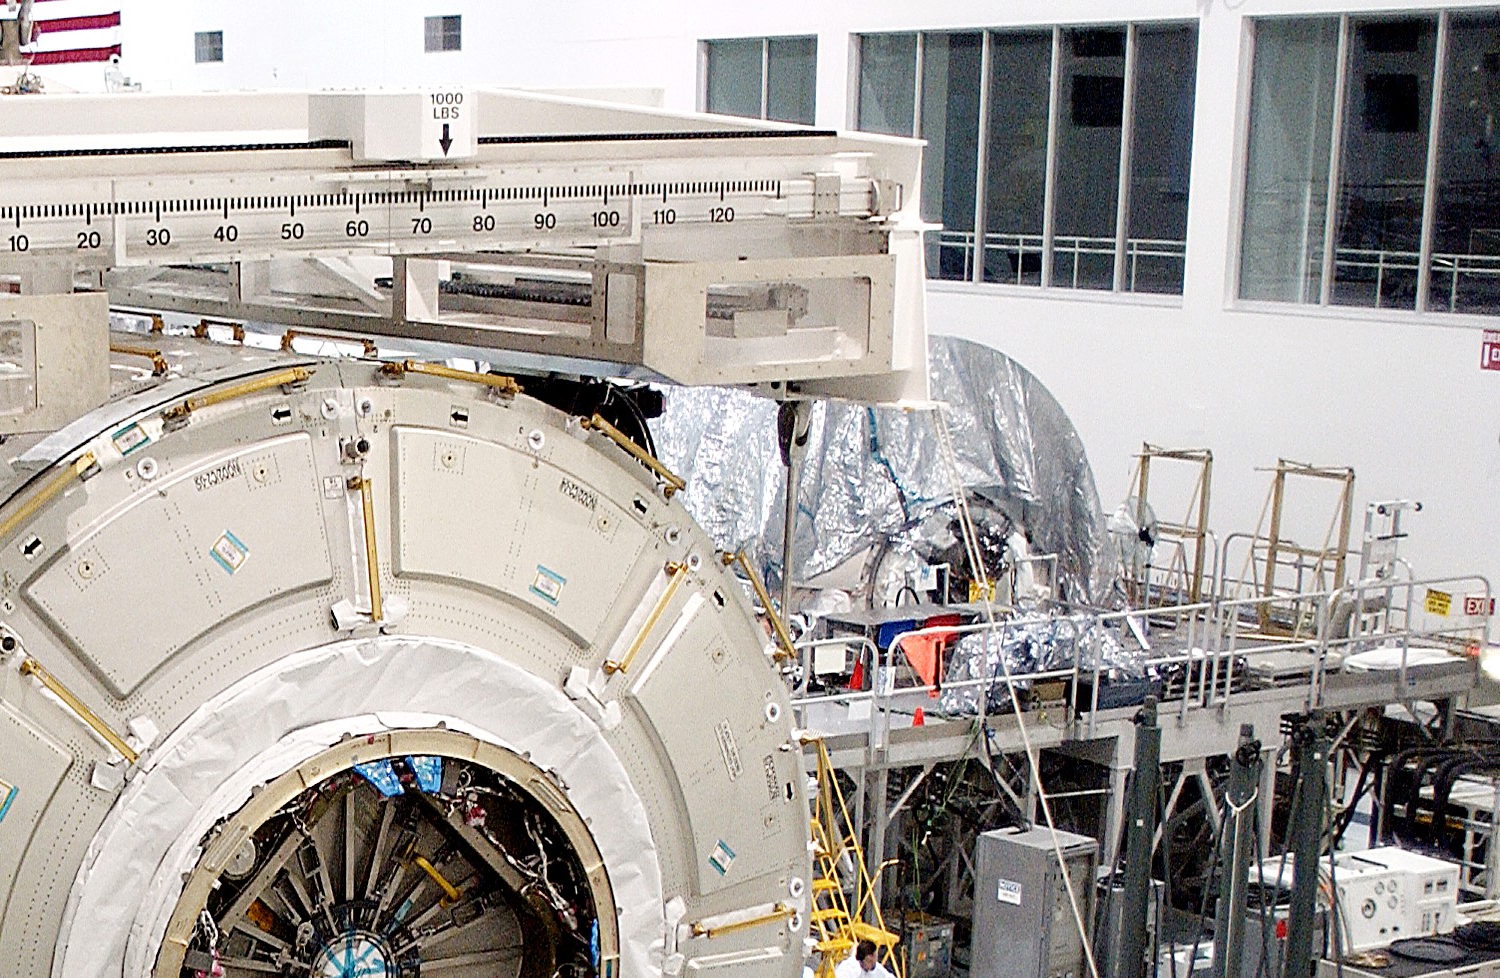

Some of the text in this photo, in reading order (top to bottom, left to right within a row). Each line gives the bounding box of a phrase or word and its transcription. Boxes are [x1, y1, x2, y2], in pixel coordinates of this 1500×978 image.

[431, 93, 463, 105] 1000
[433, 107, 459, 119] LBS
[9, 235, 29, 251] 10
[77, 232, 101, 249] 20
[146, 229, 171, 246] 30
[214, 226, 238, 242] 40
[281, 223, 305, 239] 50
[346, 221, 369, 236] 60
[411, 218, 432, 233] 70
[472, 216, 495, 231] 80
[534, 214, 556, 229] 90
[592, 212, 620, 227] 100
[653, 209, 676, 224] 110
[710, 207, 735, 222] 120
